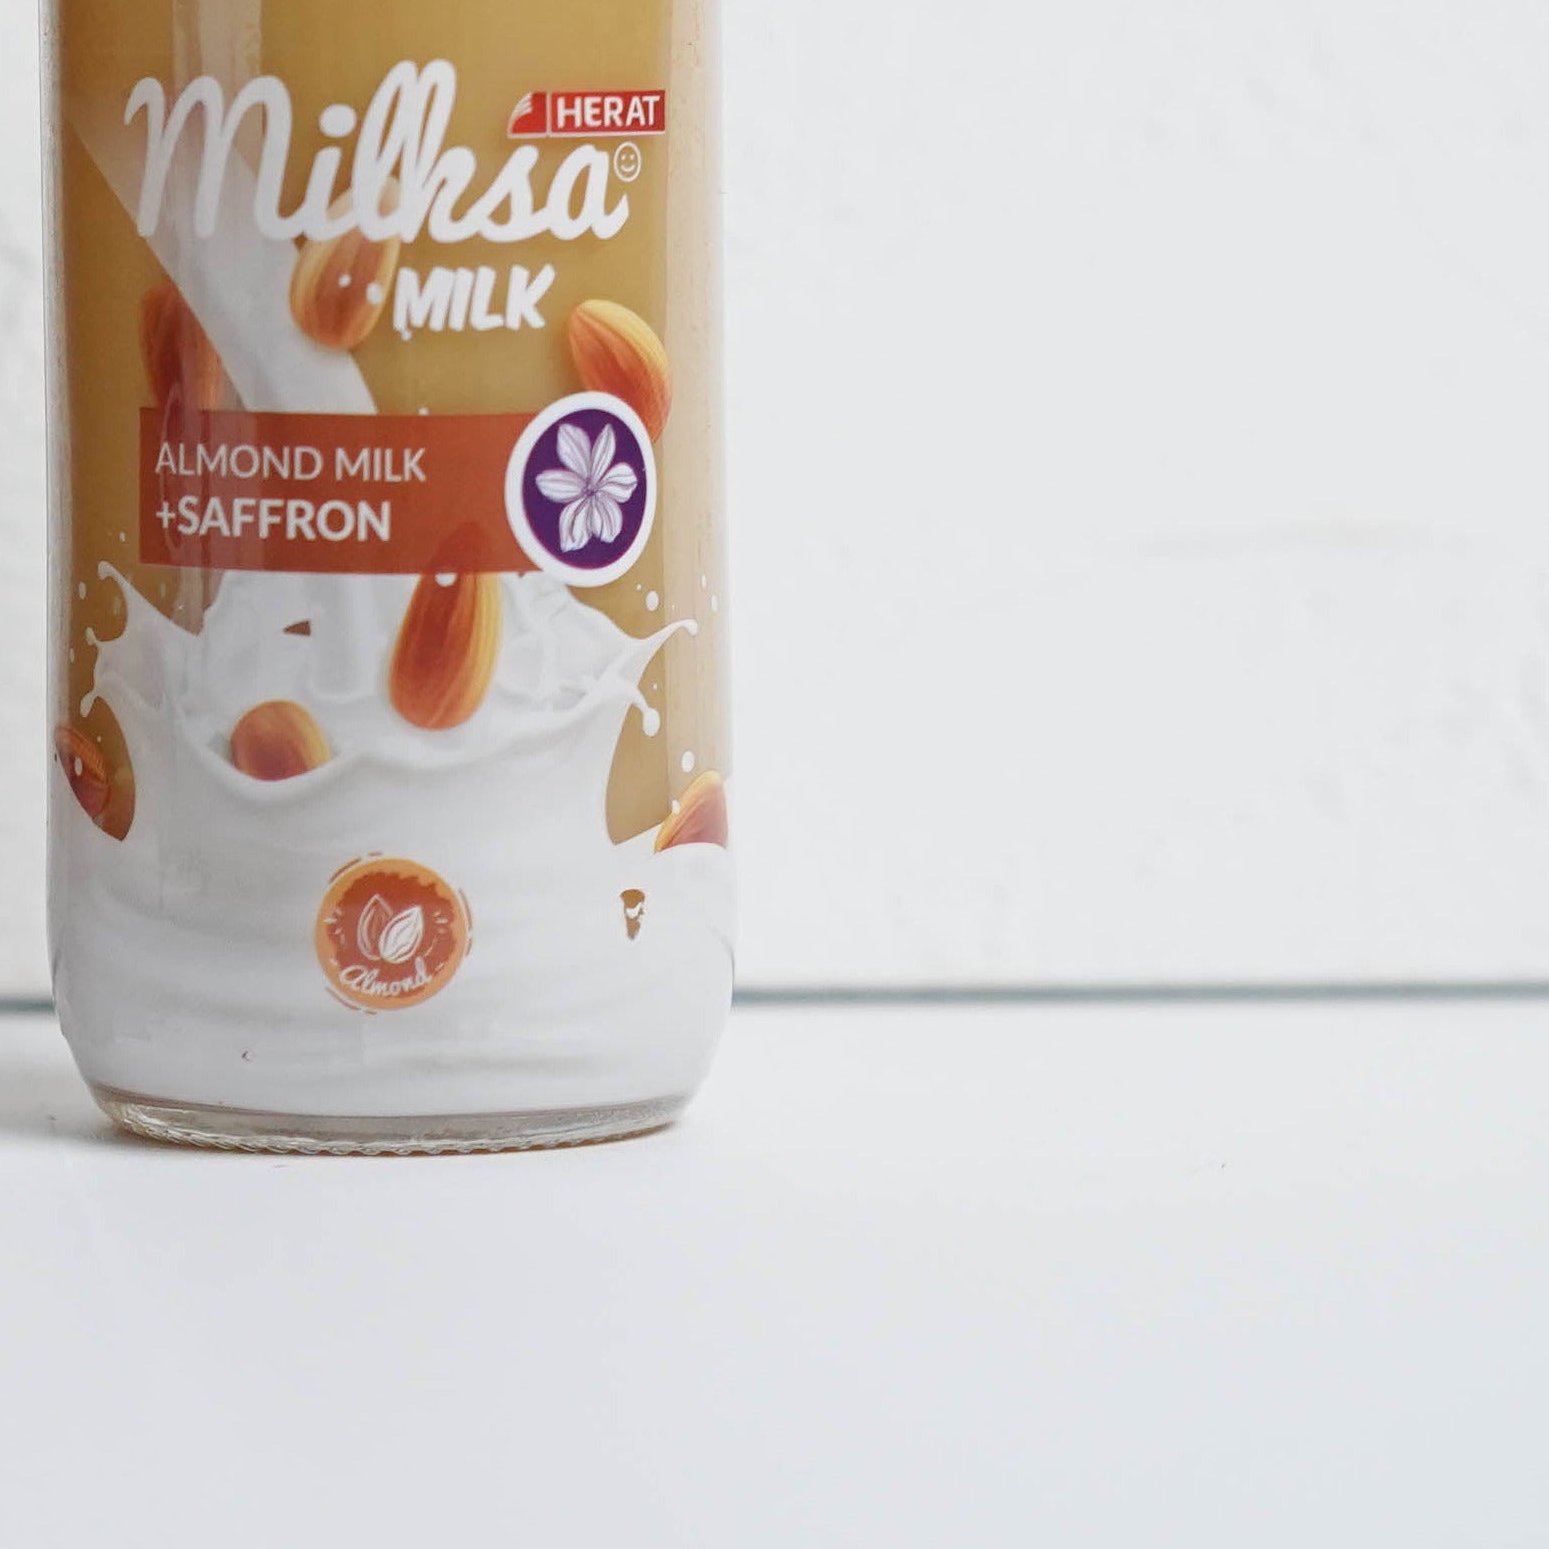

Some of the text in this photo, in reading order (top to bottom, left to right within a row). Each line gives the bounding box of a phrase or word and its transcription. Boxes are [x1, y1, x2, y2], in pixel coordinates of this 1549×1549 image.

[556, 93, 662, 129] HERAT
[124, 58, 631, 243] Milksa
[393, 263, 557, 341] MILK
[154, 441, 428, 483] ALMOND MILK
[155, 494, 392, 543] +SAFFRON
[338, 955, 433, 996] Almond
